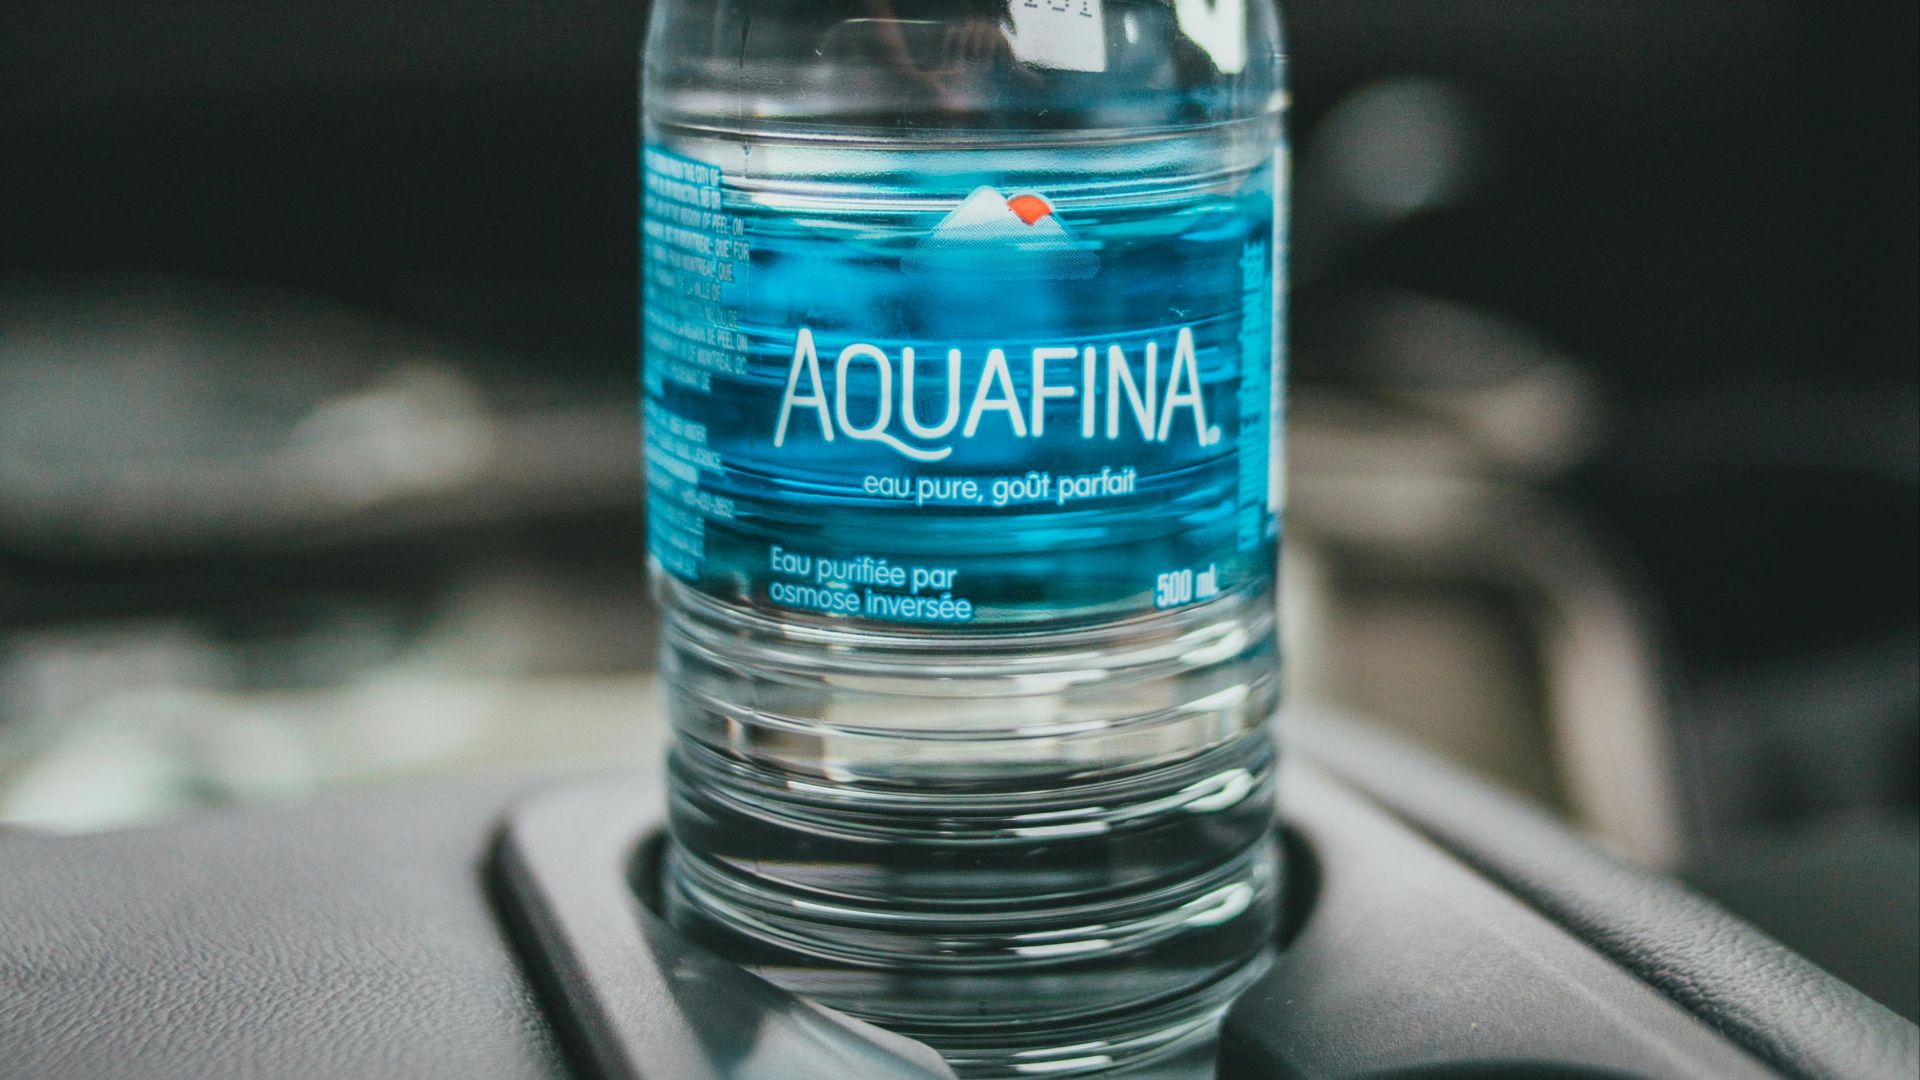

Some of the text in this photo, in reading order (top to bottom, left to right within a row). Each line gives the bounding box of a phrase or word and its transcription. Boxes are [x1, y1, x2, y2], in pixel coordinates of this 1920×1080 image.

[733, 241, 750, 261] FOR
[774, 327, 1209, 462] AQUAFINA
[864, 468, 1136, 505] eau pure, goût parfait
[771, 546, 958, 593] Eau purifiée par
[1157, 569, 1193, 608] 500
[771, 582, 972, 618] osmose inversée
